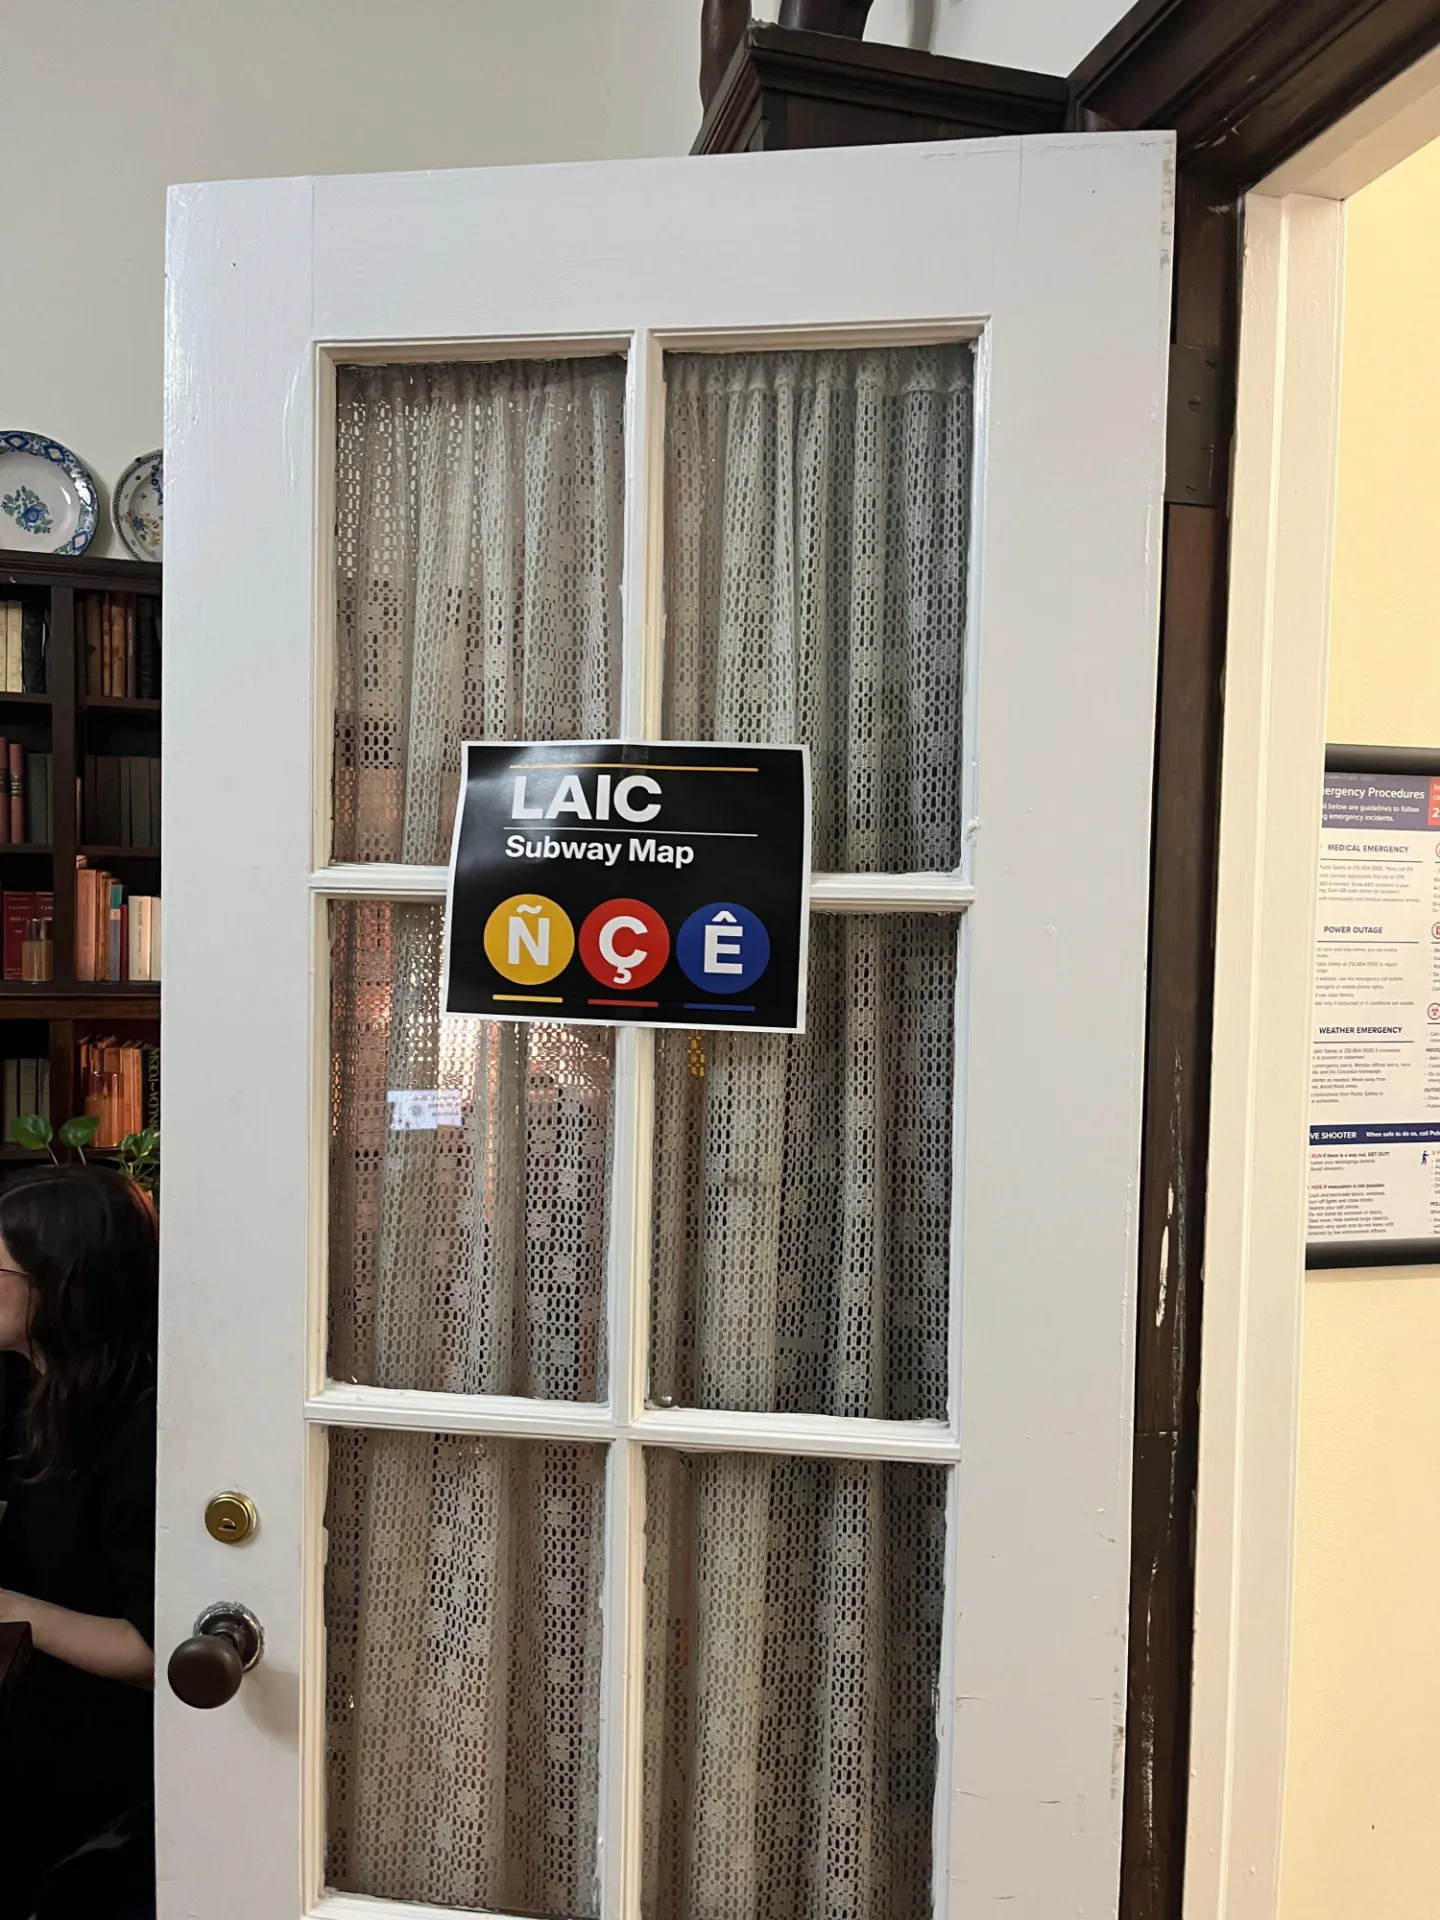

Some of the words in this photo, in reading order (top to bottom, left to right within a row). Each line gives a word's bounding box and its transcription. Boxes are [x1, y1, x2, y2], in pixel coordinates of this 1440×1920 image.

[511, 774, 662, 822] LAIC
[1323, 787, 1365, 799] ergency
[1368, 787, 1425, 799] Procedures
[505, 834, 622, 866] Subway
[629, 838, 694, 869] Map
[1328, 844, 1360, 852] MEDICAL
[1363, 845, 1409, 853] EMERGENCY
[508, 904, 550, 966] Ñ
[599, 916, 648, 984] Ç
[704, 911, 743, 975] Ê
